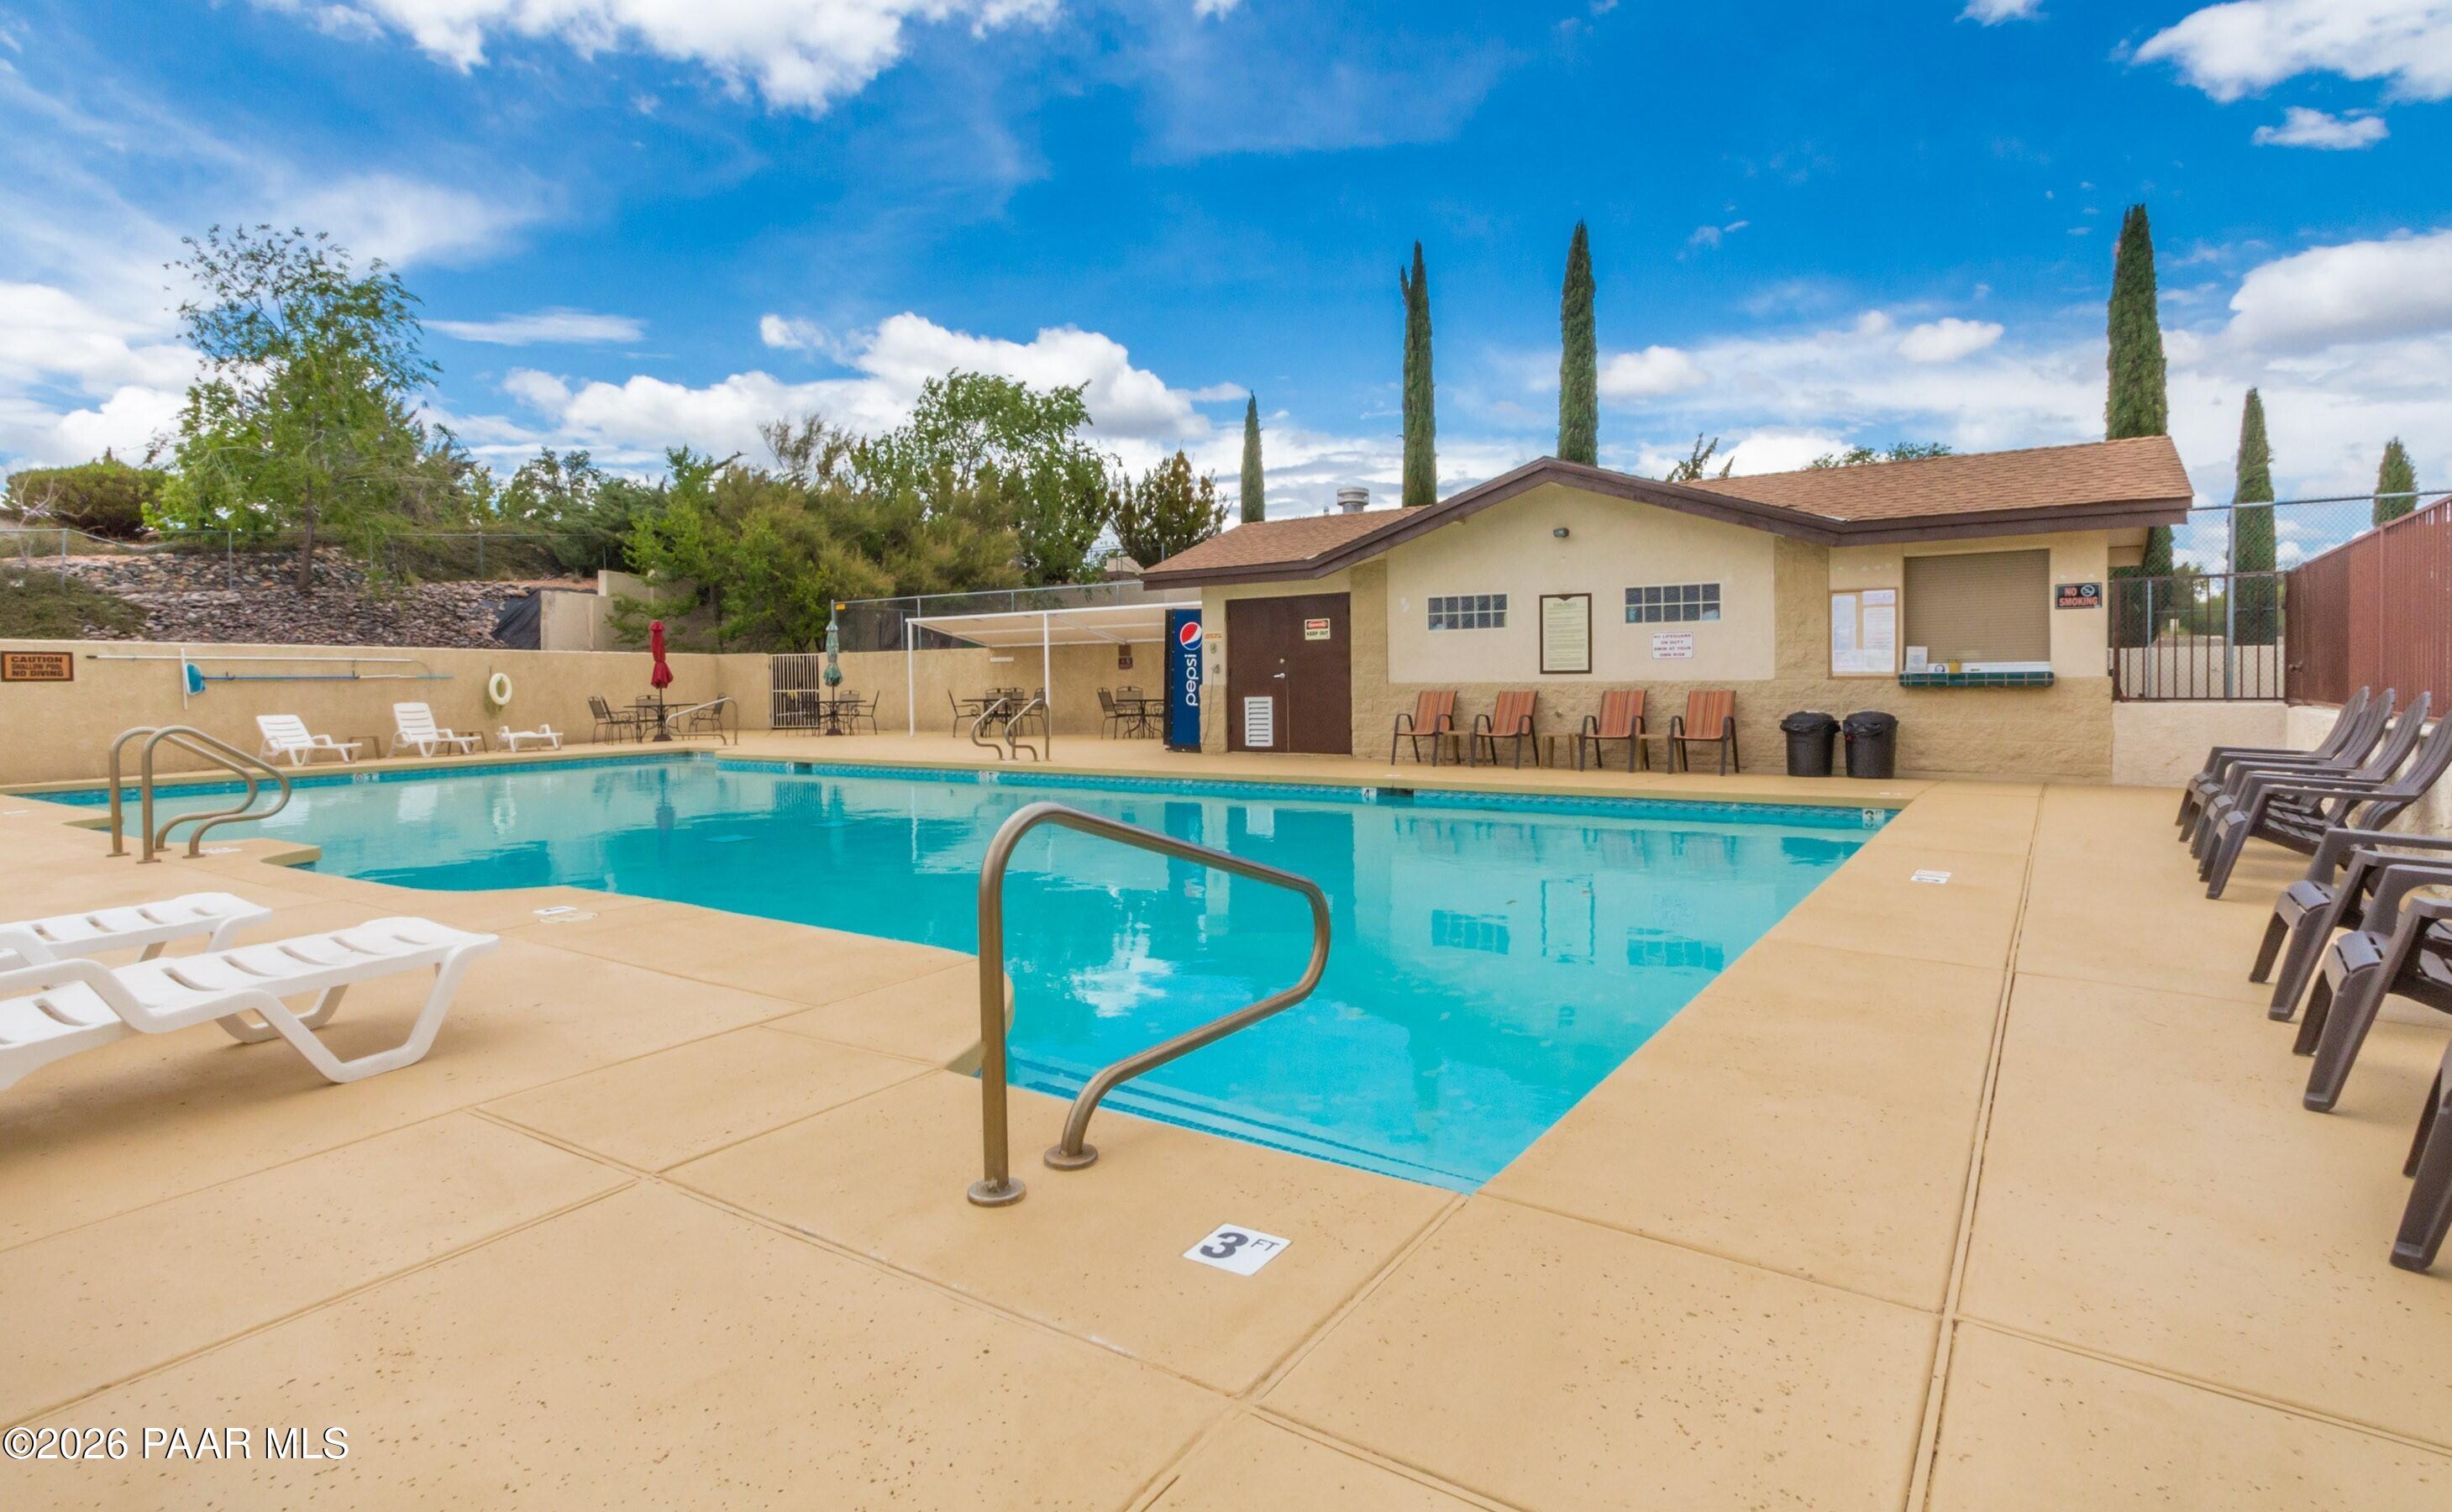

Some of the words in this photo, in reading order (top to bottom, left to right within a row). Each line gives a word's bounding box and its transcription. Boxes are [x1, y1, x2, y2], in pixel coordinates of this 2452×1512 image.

[2064, 587, 2077, 596] NO
[2059, 597, 2098, 606] SMOKING
[1184, 654, 1200, 706] pepsi
[1864, 810, 1875, 821] 3
[1200, 1231, 1249, 1258] 3
[1250, 1238, 1281, 1252] FT
